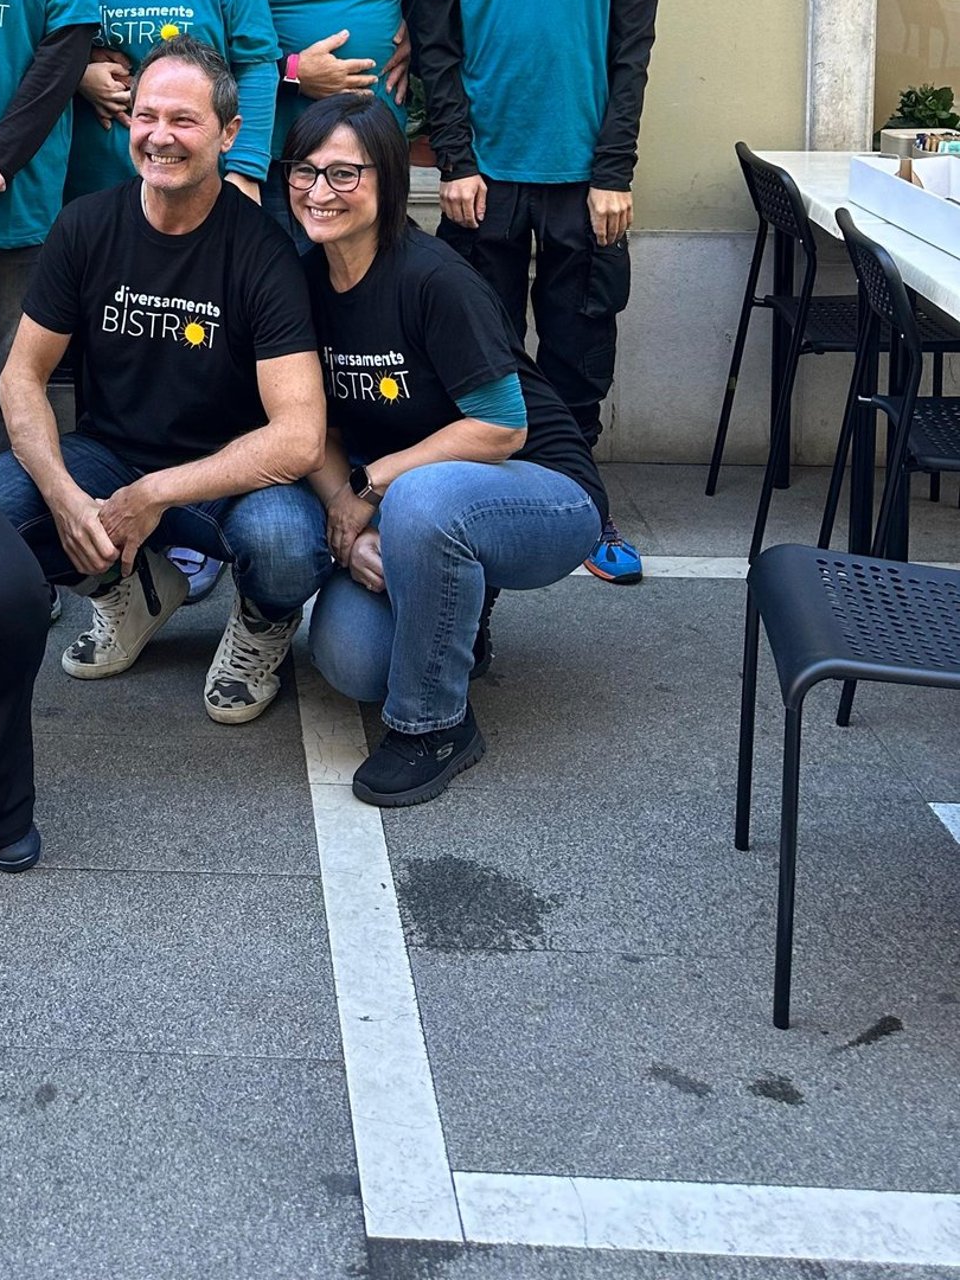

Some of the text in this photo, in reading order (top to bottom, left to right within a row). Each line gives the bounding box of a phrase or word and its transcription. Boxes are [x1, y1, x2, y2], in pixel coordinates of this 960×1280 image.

[99, 4, 195, 22] iversamente
[114, 284, 222, 318] diversamente
[102, 304, 220, 349] BISTROT
[324, 345, 405, 369] iversamente
[328, 370, 411, 402] ISTROT
